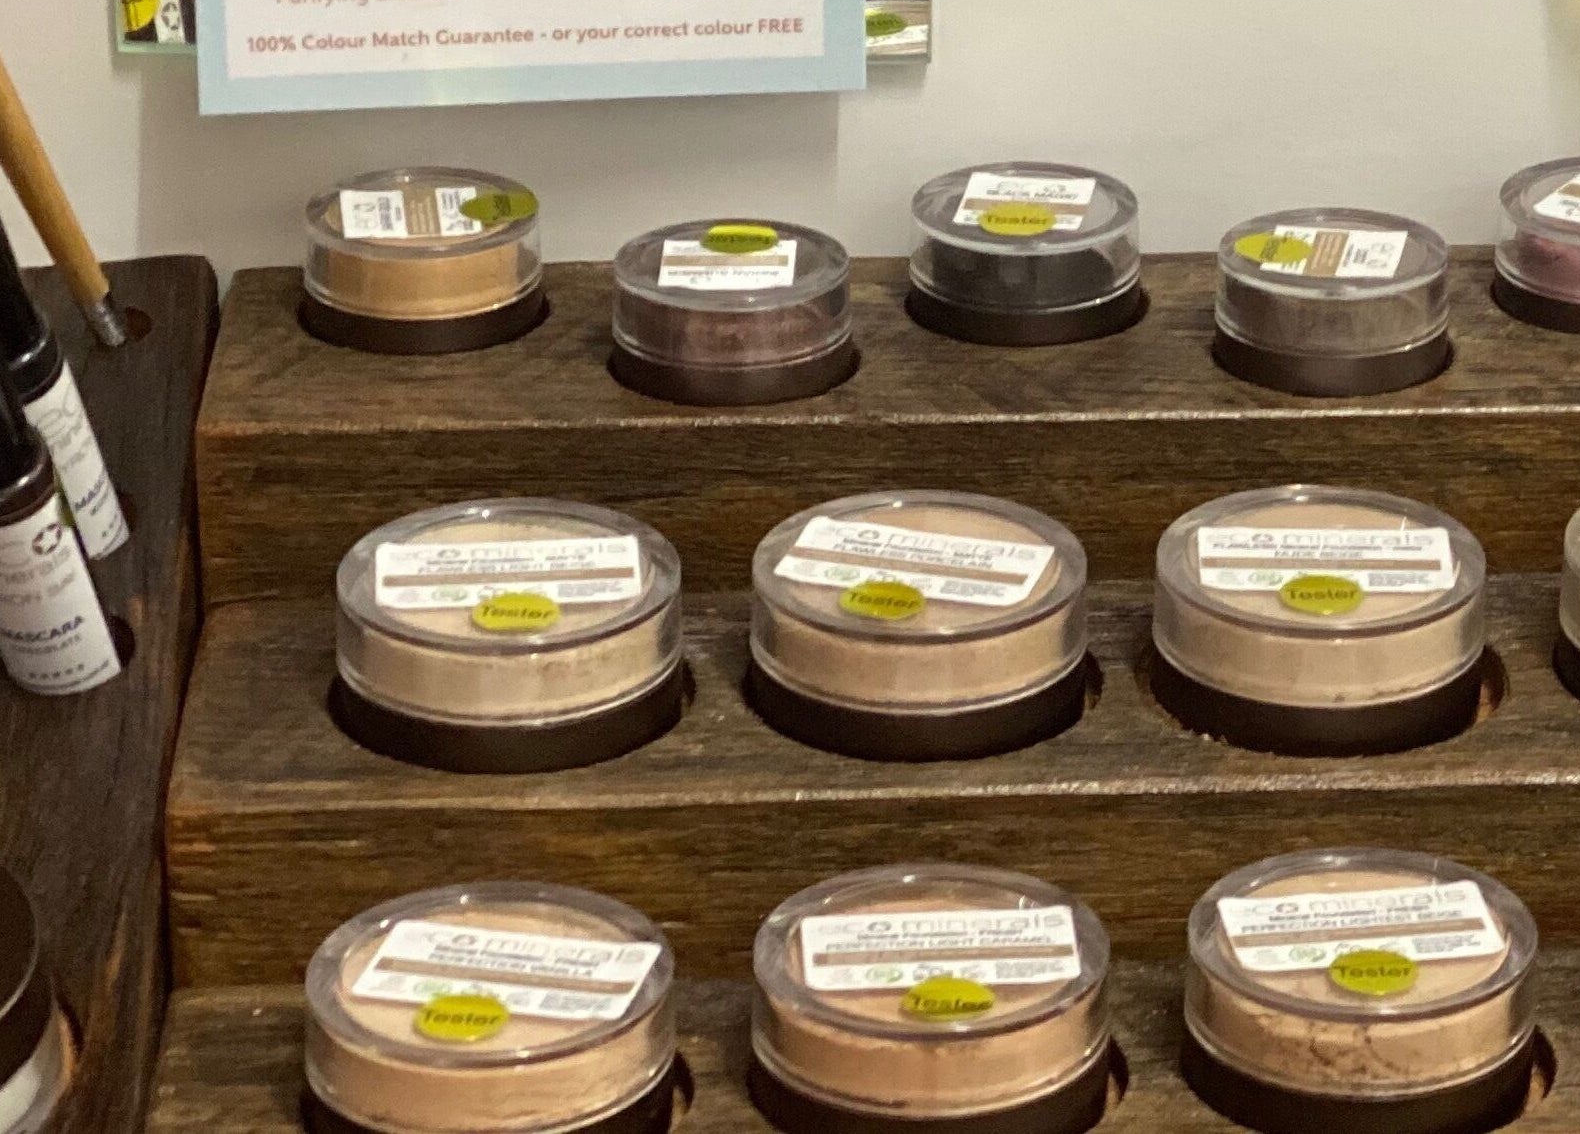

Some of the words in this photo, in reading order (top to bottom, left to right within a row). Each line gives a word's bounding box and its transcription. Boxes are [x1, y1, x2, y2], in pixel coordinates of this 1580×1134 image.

[247, 35, 296, 53] 100%
[301, 33, 366, 51] Colour
[372, 29, 430, 48] Match
[435, 28, 534, 46] Guarantee
[552, 28, 572, 41] or
[576, 27, 619, 45] your
[624, 21, 689, 39] correct
[694, 19, 753, 36] colour
[758, 17, 803, 34] FREE
